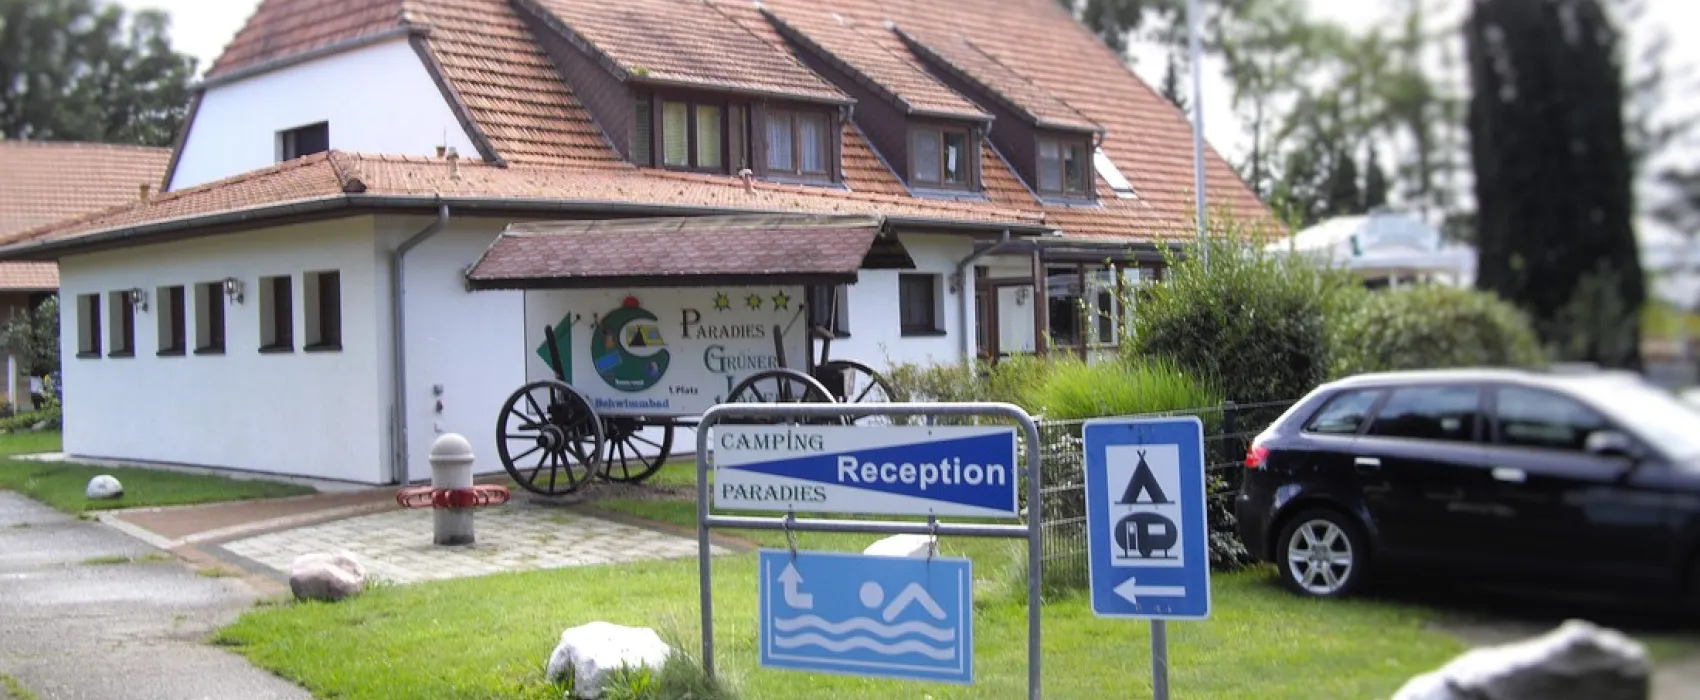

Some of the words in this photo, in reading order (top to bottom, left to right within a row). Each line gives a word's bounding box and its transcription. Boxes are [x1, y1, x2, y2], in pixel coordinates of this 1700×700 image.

[681, 308, 766, 340] PARADIES
[721, 432, 824, 451] CAMPING
[837, 456, 1006, 490] Reception
[722, 483, 827, 502] PARADIES
